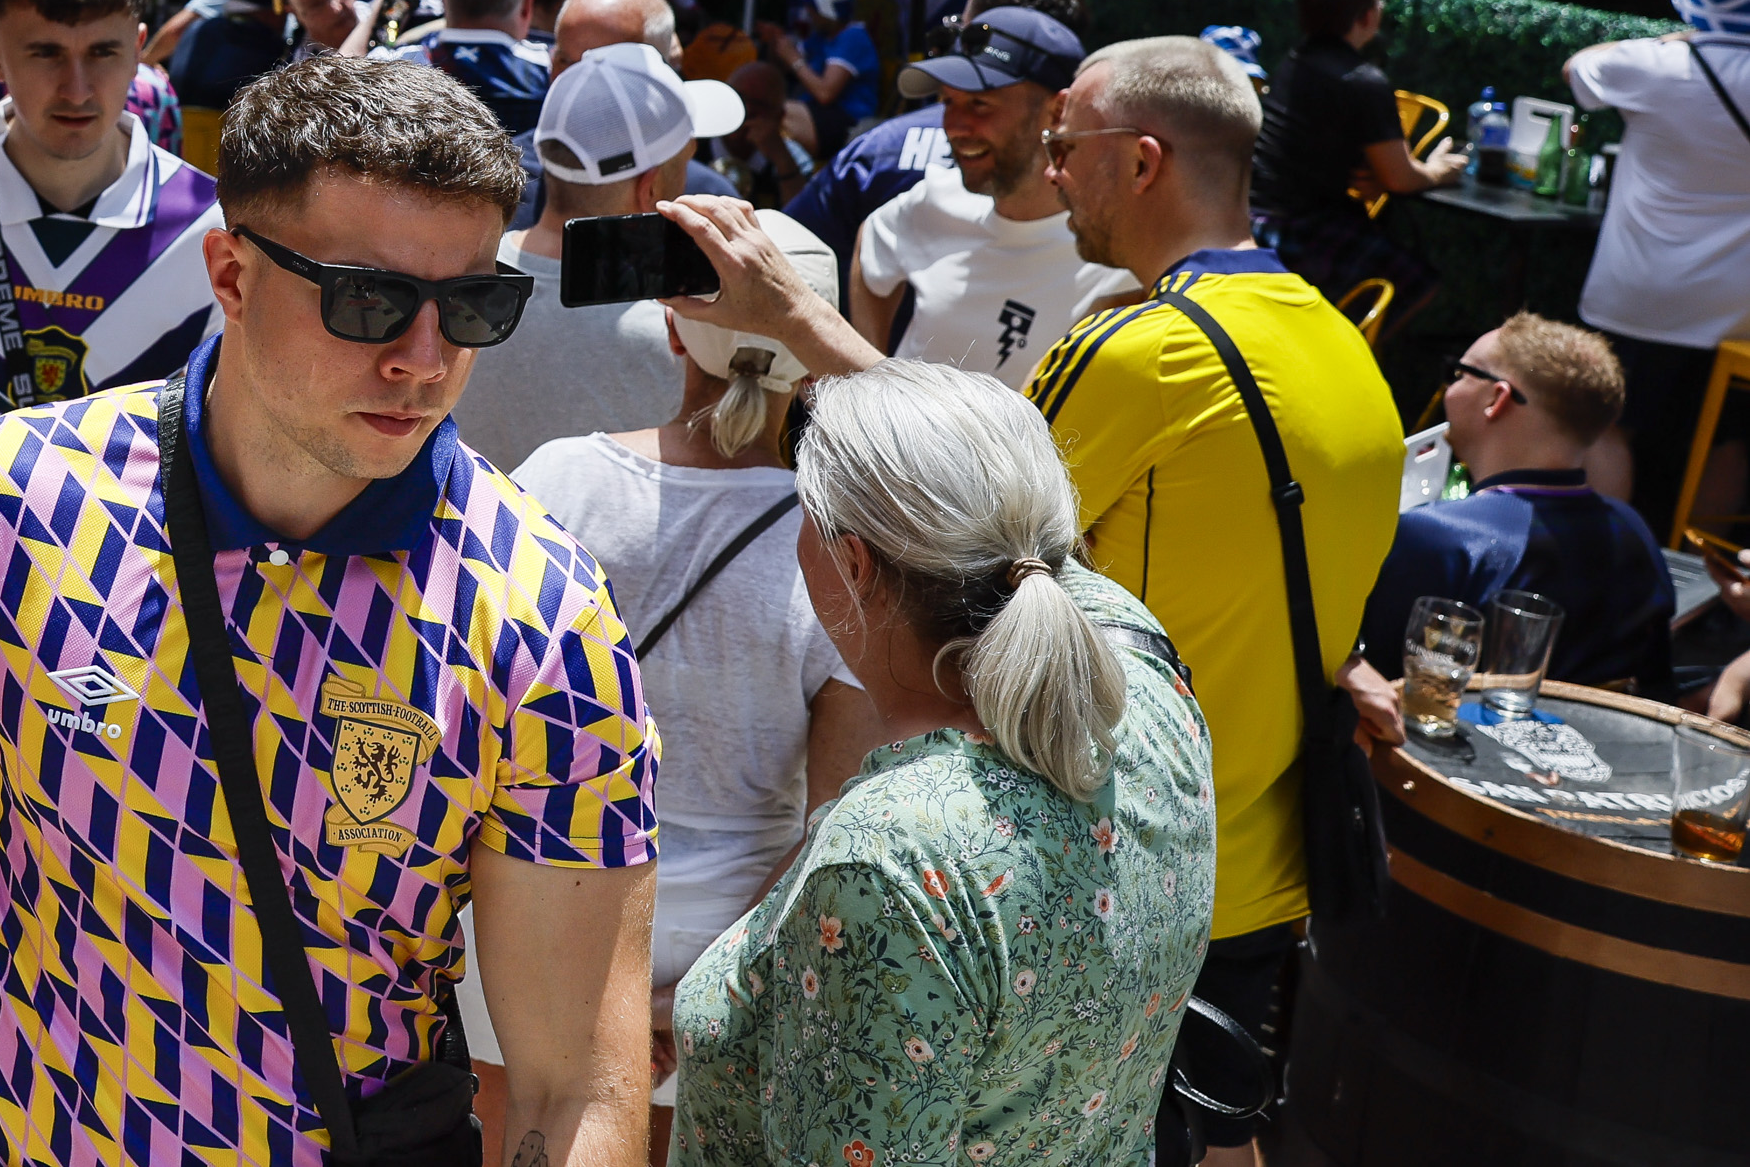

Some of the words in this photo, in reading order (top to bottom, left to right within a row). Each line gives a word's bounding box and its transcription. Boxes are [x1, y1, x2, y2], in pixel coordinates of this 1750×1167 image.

[47, 708, 122, 739] umbro
[348, 702, 394, 716] SCOTTISH
[394, 707, 439, 741] FOOTBALL
[337, 827, 403, 844] ASSOCIATION
